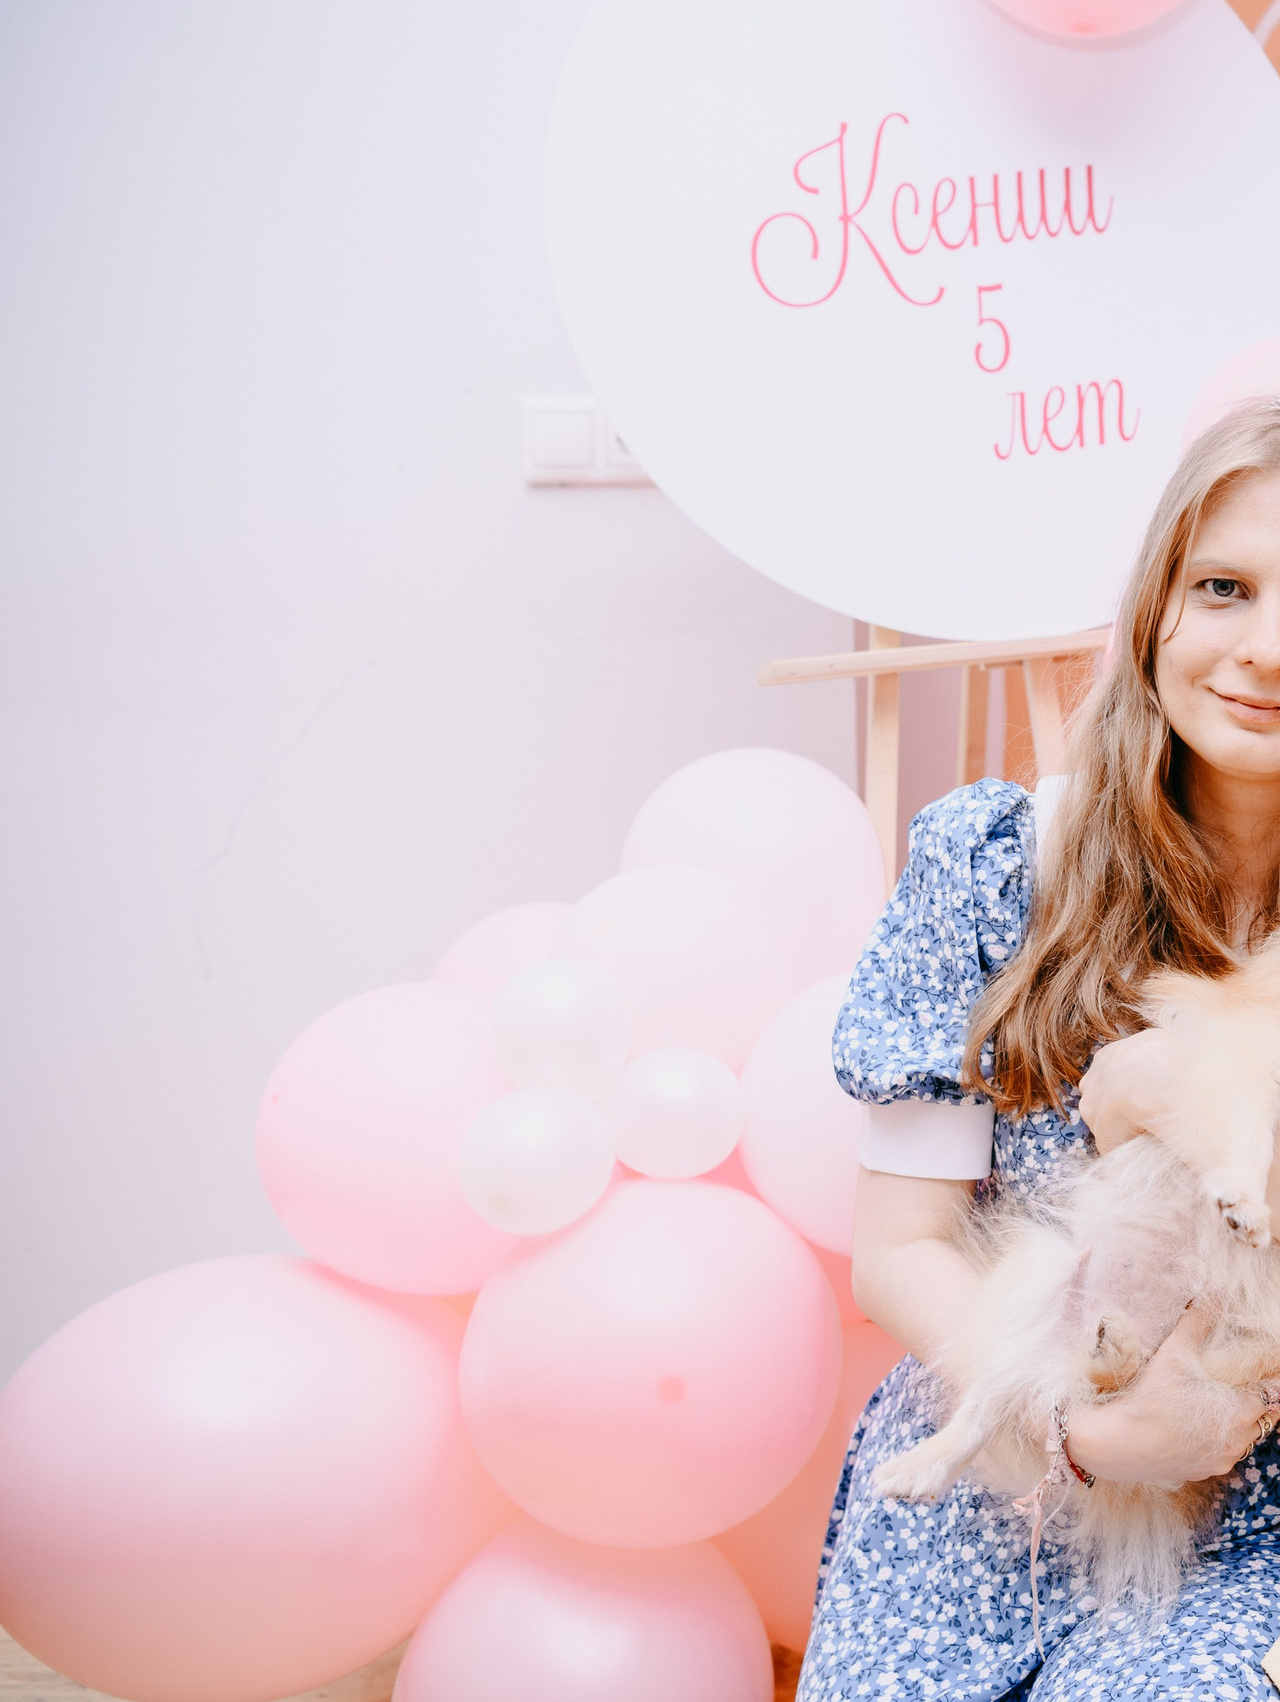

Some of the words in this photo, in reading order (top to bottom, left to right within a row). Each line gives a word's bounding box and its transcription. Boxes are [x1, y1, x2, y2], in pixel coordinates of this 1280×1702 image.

[750, 112, 1115, 308] Ксении
[974, 283, 1011, 373] 5
[993, 378, 1141, 461] лет
